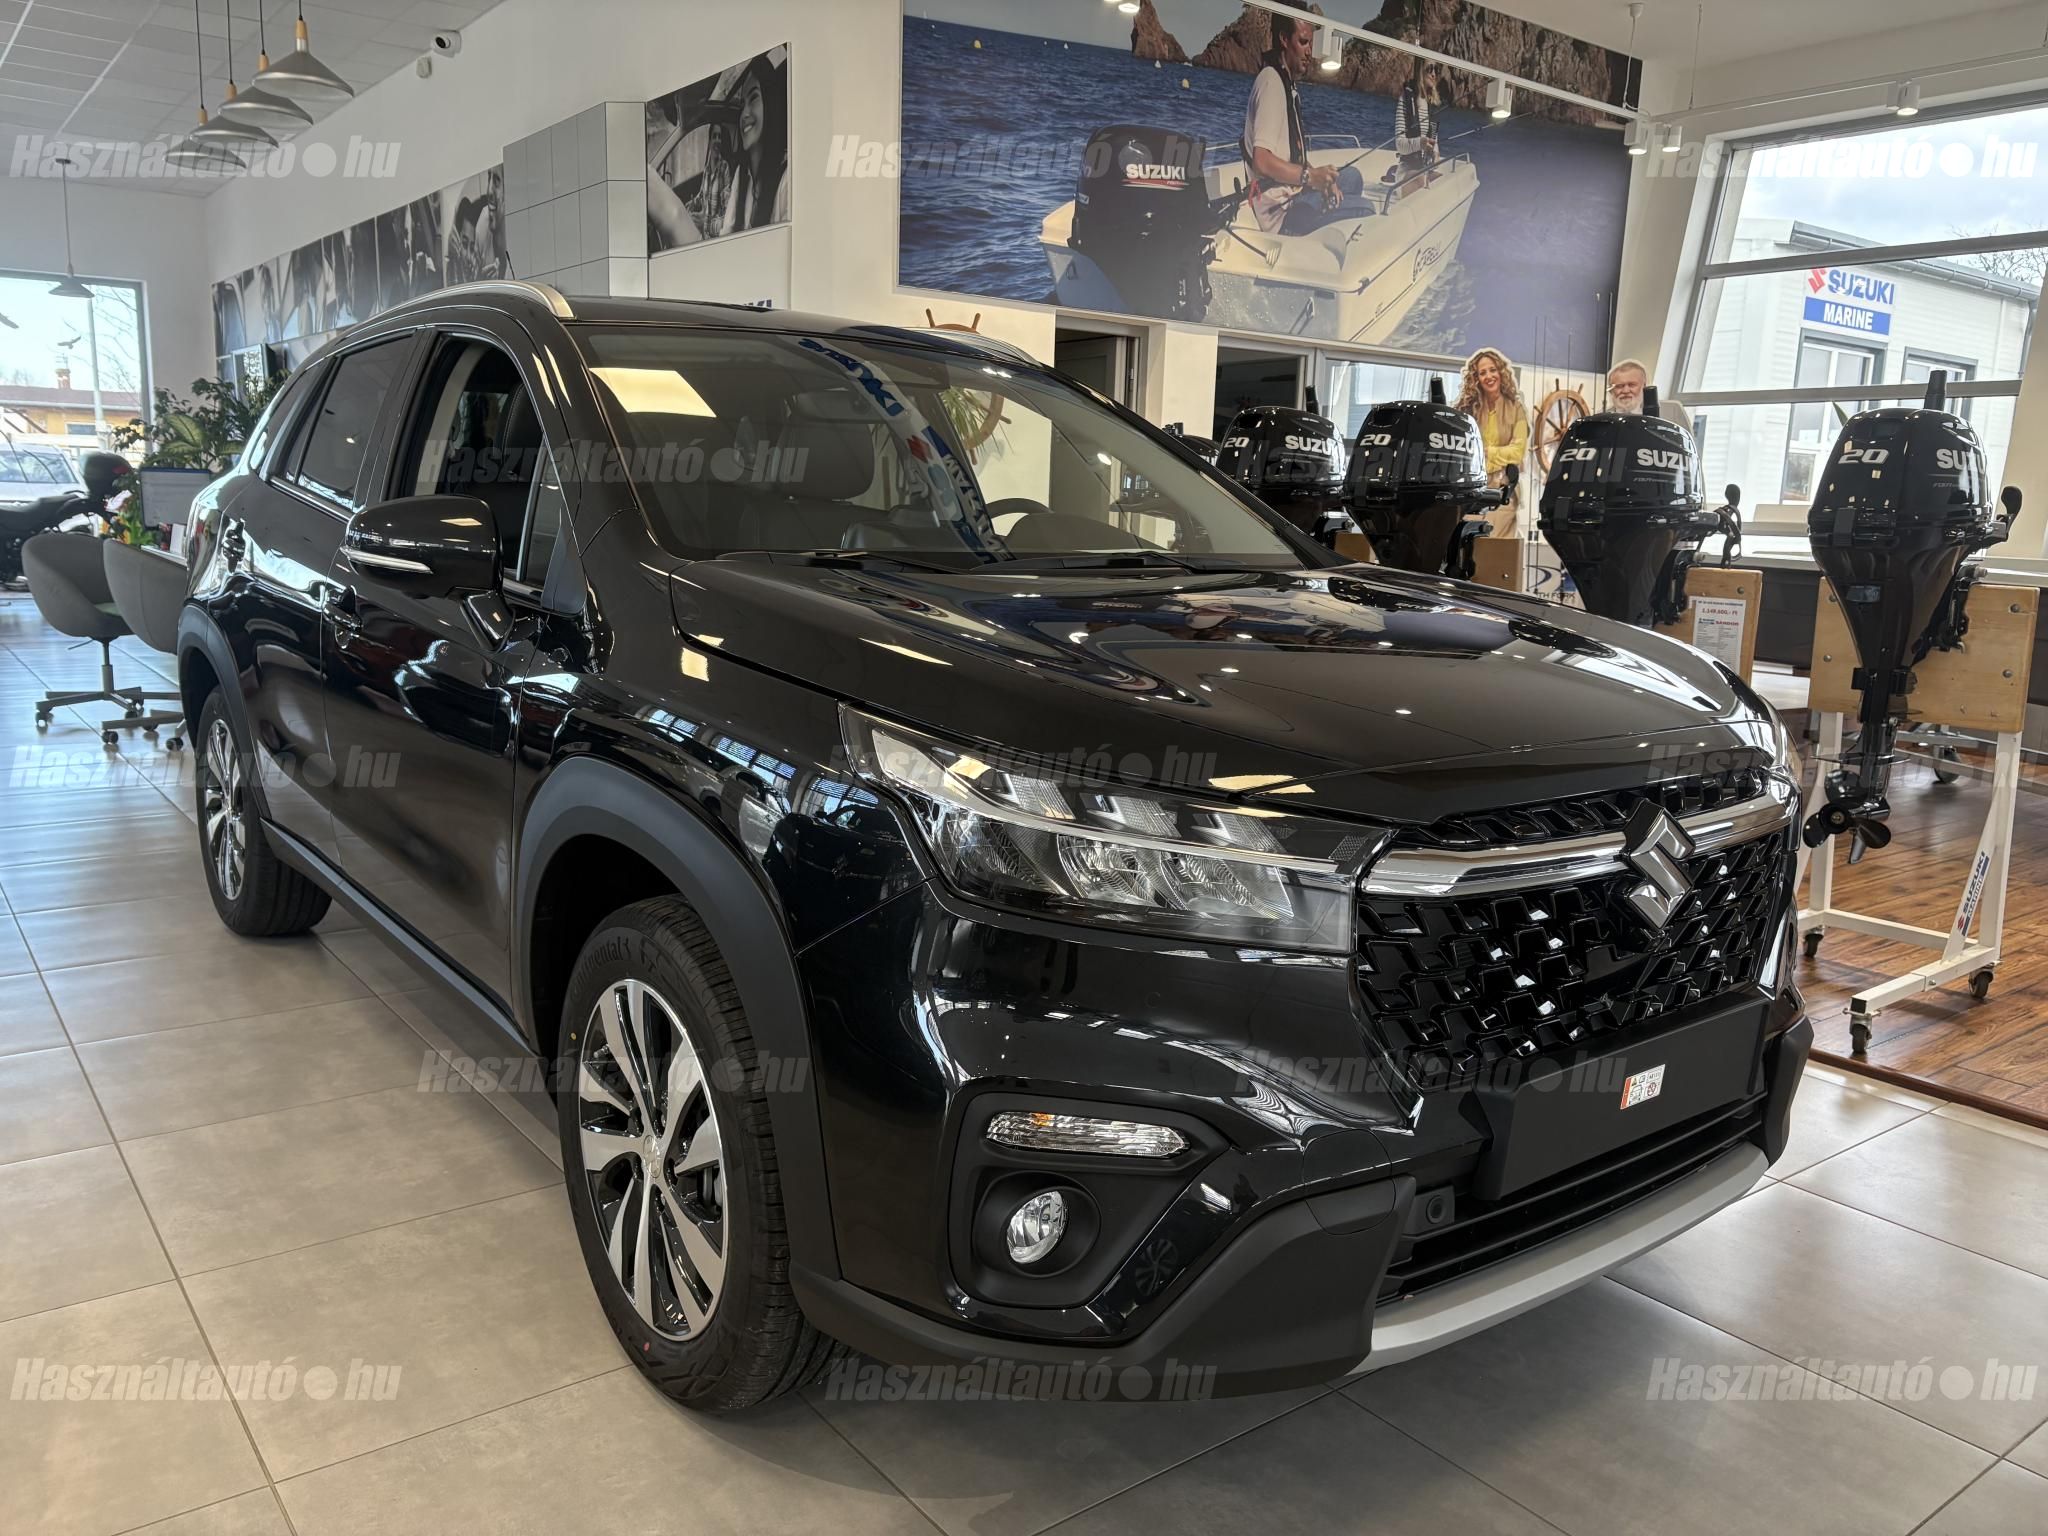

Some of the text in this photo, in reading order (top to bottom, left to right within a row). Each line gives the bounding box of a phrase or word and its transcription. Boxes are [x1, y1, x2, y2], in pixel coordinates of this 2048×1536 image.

[1126, 163, 1185, 180] SUZUKI
[1828, 269, 1895, 304] SUZUKI
[1823, 302, 1874, 330] MARINE
[1224, 434, 1334, 456] 20 SUZU
[1359, 432, 1475, 454] 20 SUZU
[1559, 447, 1690, 471] 20 SUZU
[1837, 448, 1889, 464] 20
